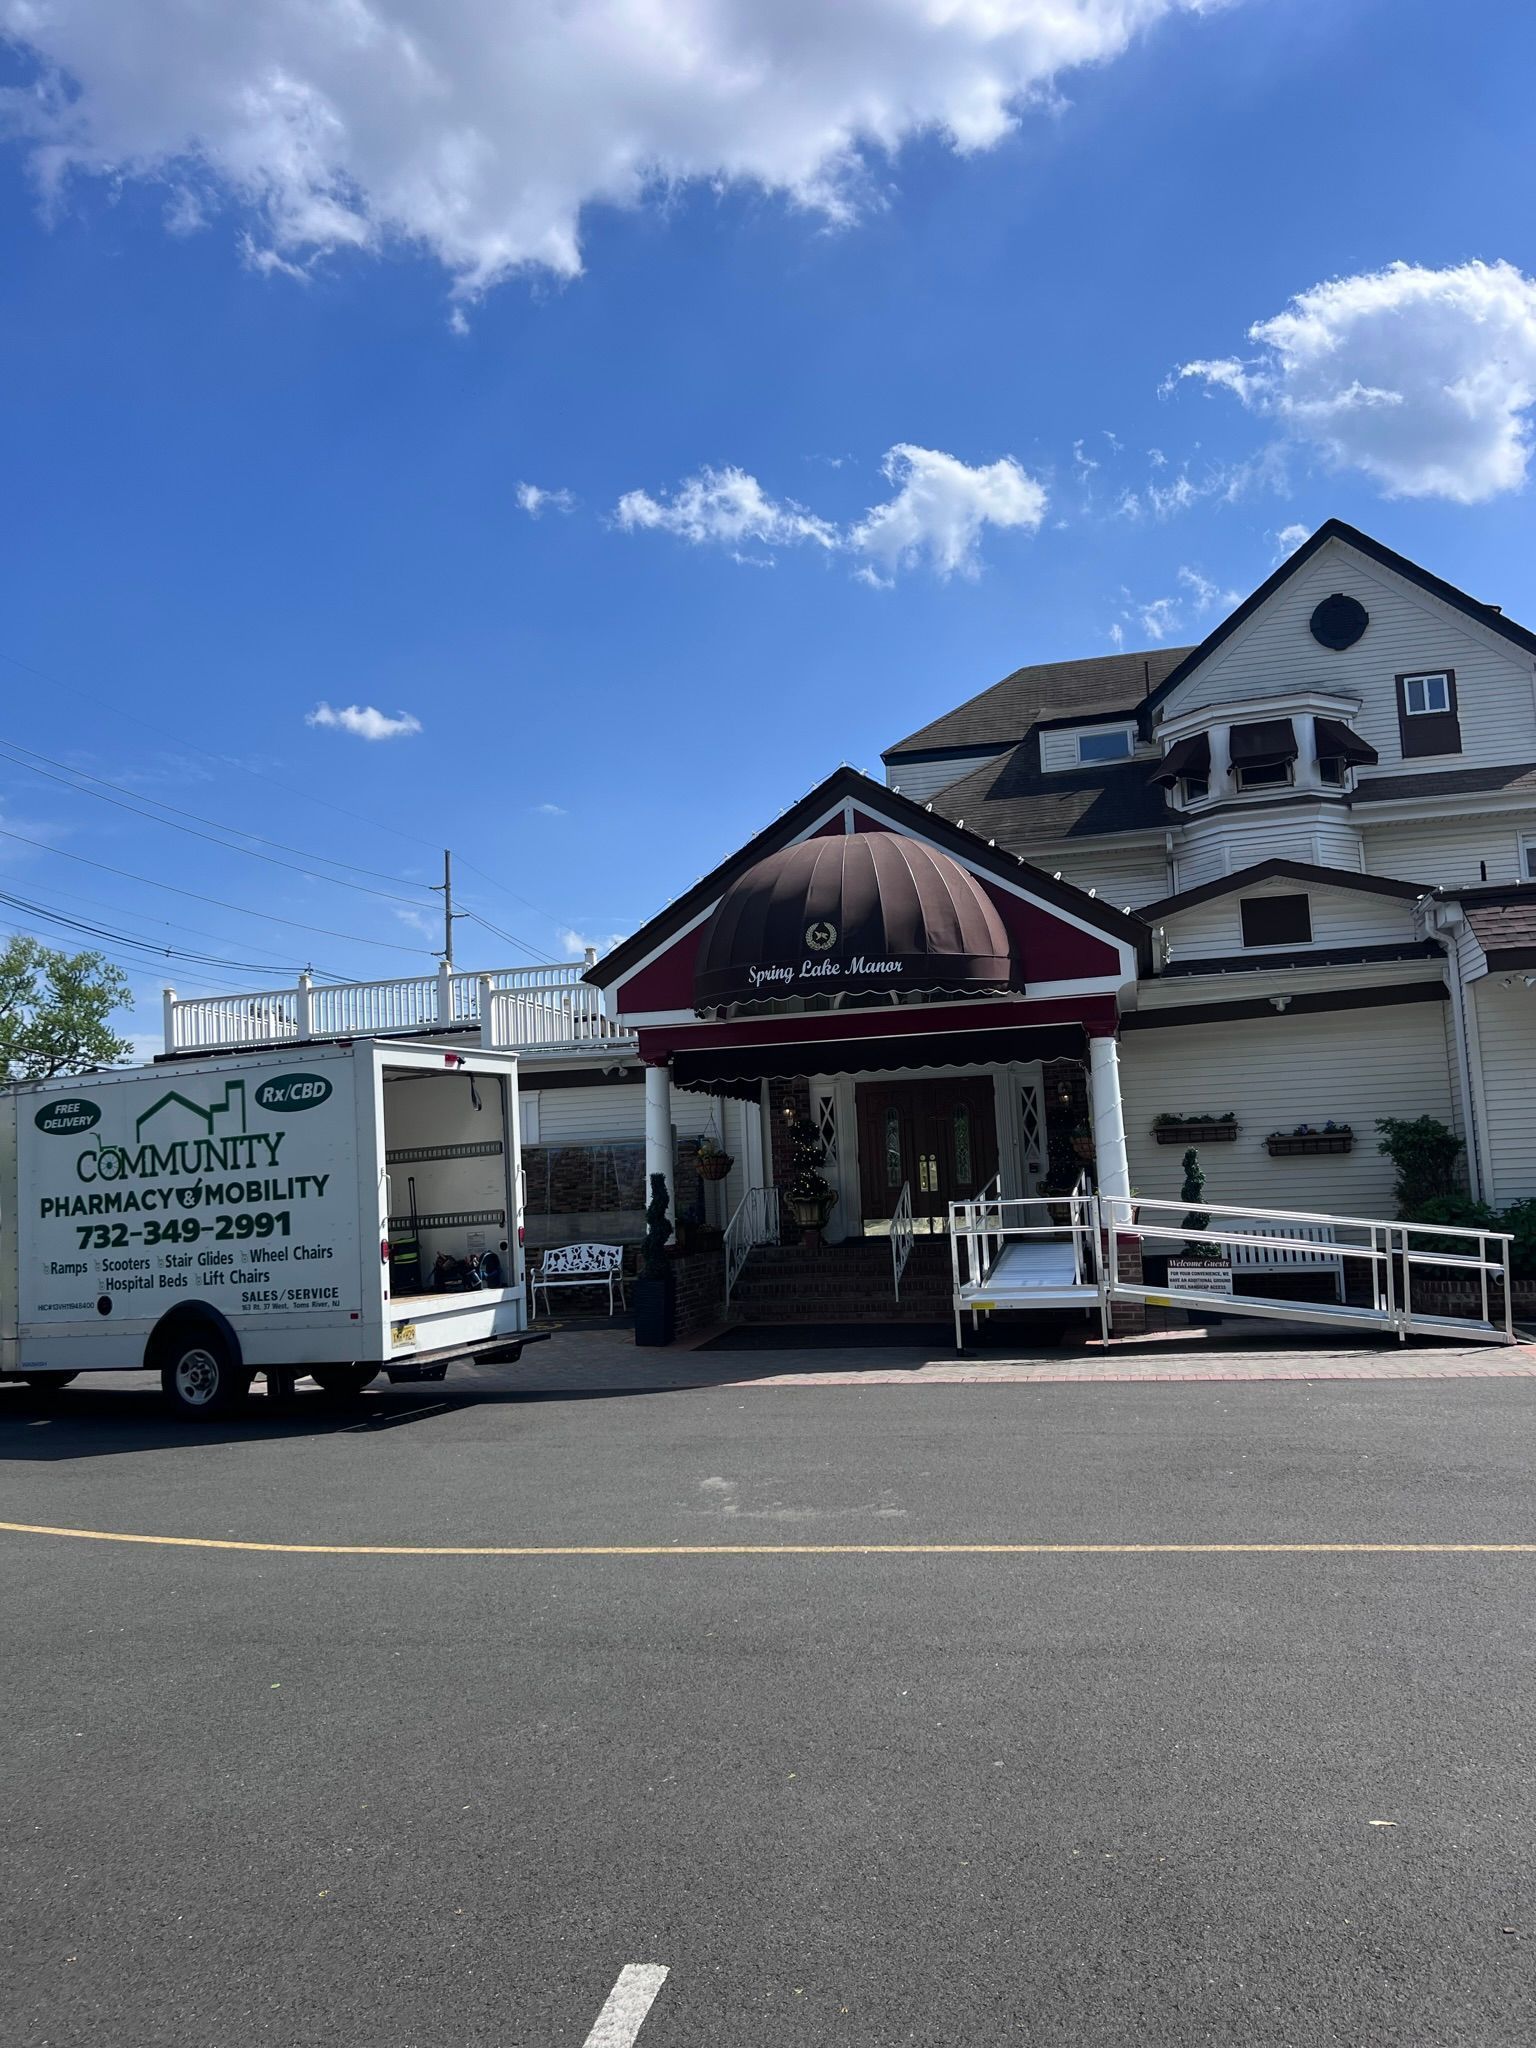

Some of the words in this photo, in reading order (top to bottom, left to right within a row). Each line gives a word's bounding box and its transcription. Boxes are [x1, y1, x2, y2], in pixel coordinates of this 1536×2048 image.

[748, 965, 794, 987] Spring
[799, 958, 840, 977] Lake
[845, 956, 903, 975] Manor
[262, 1081, 326, 1103] Rx/CBD
[44, 1115, 93, 1129] DELIVERY
[54, 1103, 80, 1115] FREE
[77, 1132, 286, 1182] COMMUNITY
[40, 1188, 174, 1218] PHARMACY
[205, 1174, 330, 1206] MOBILITY
[76, 1211, 291, 1250] 732-349-2991
[50, 1262, 88, 1277] Ramps
[102, 1258, 151, 1272] Scooters
[165, 1253, 193, 1268] Stair
[197, 1251, 234, 1266] Glides
[250, 1246, 289, 1263] Wheel
[293, 1244, 333, 1260] Chairs
[106, 1274, 154, 1292] Hospital
[159, 1273, 188, 1288] Beds
[203, 1270, 225, 1286] Lift
[230, 1268, 270, 1284] Chairs
[241, 1287, 339, 1302] SALES/SERVICE
